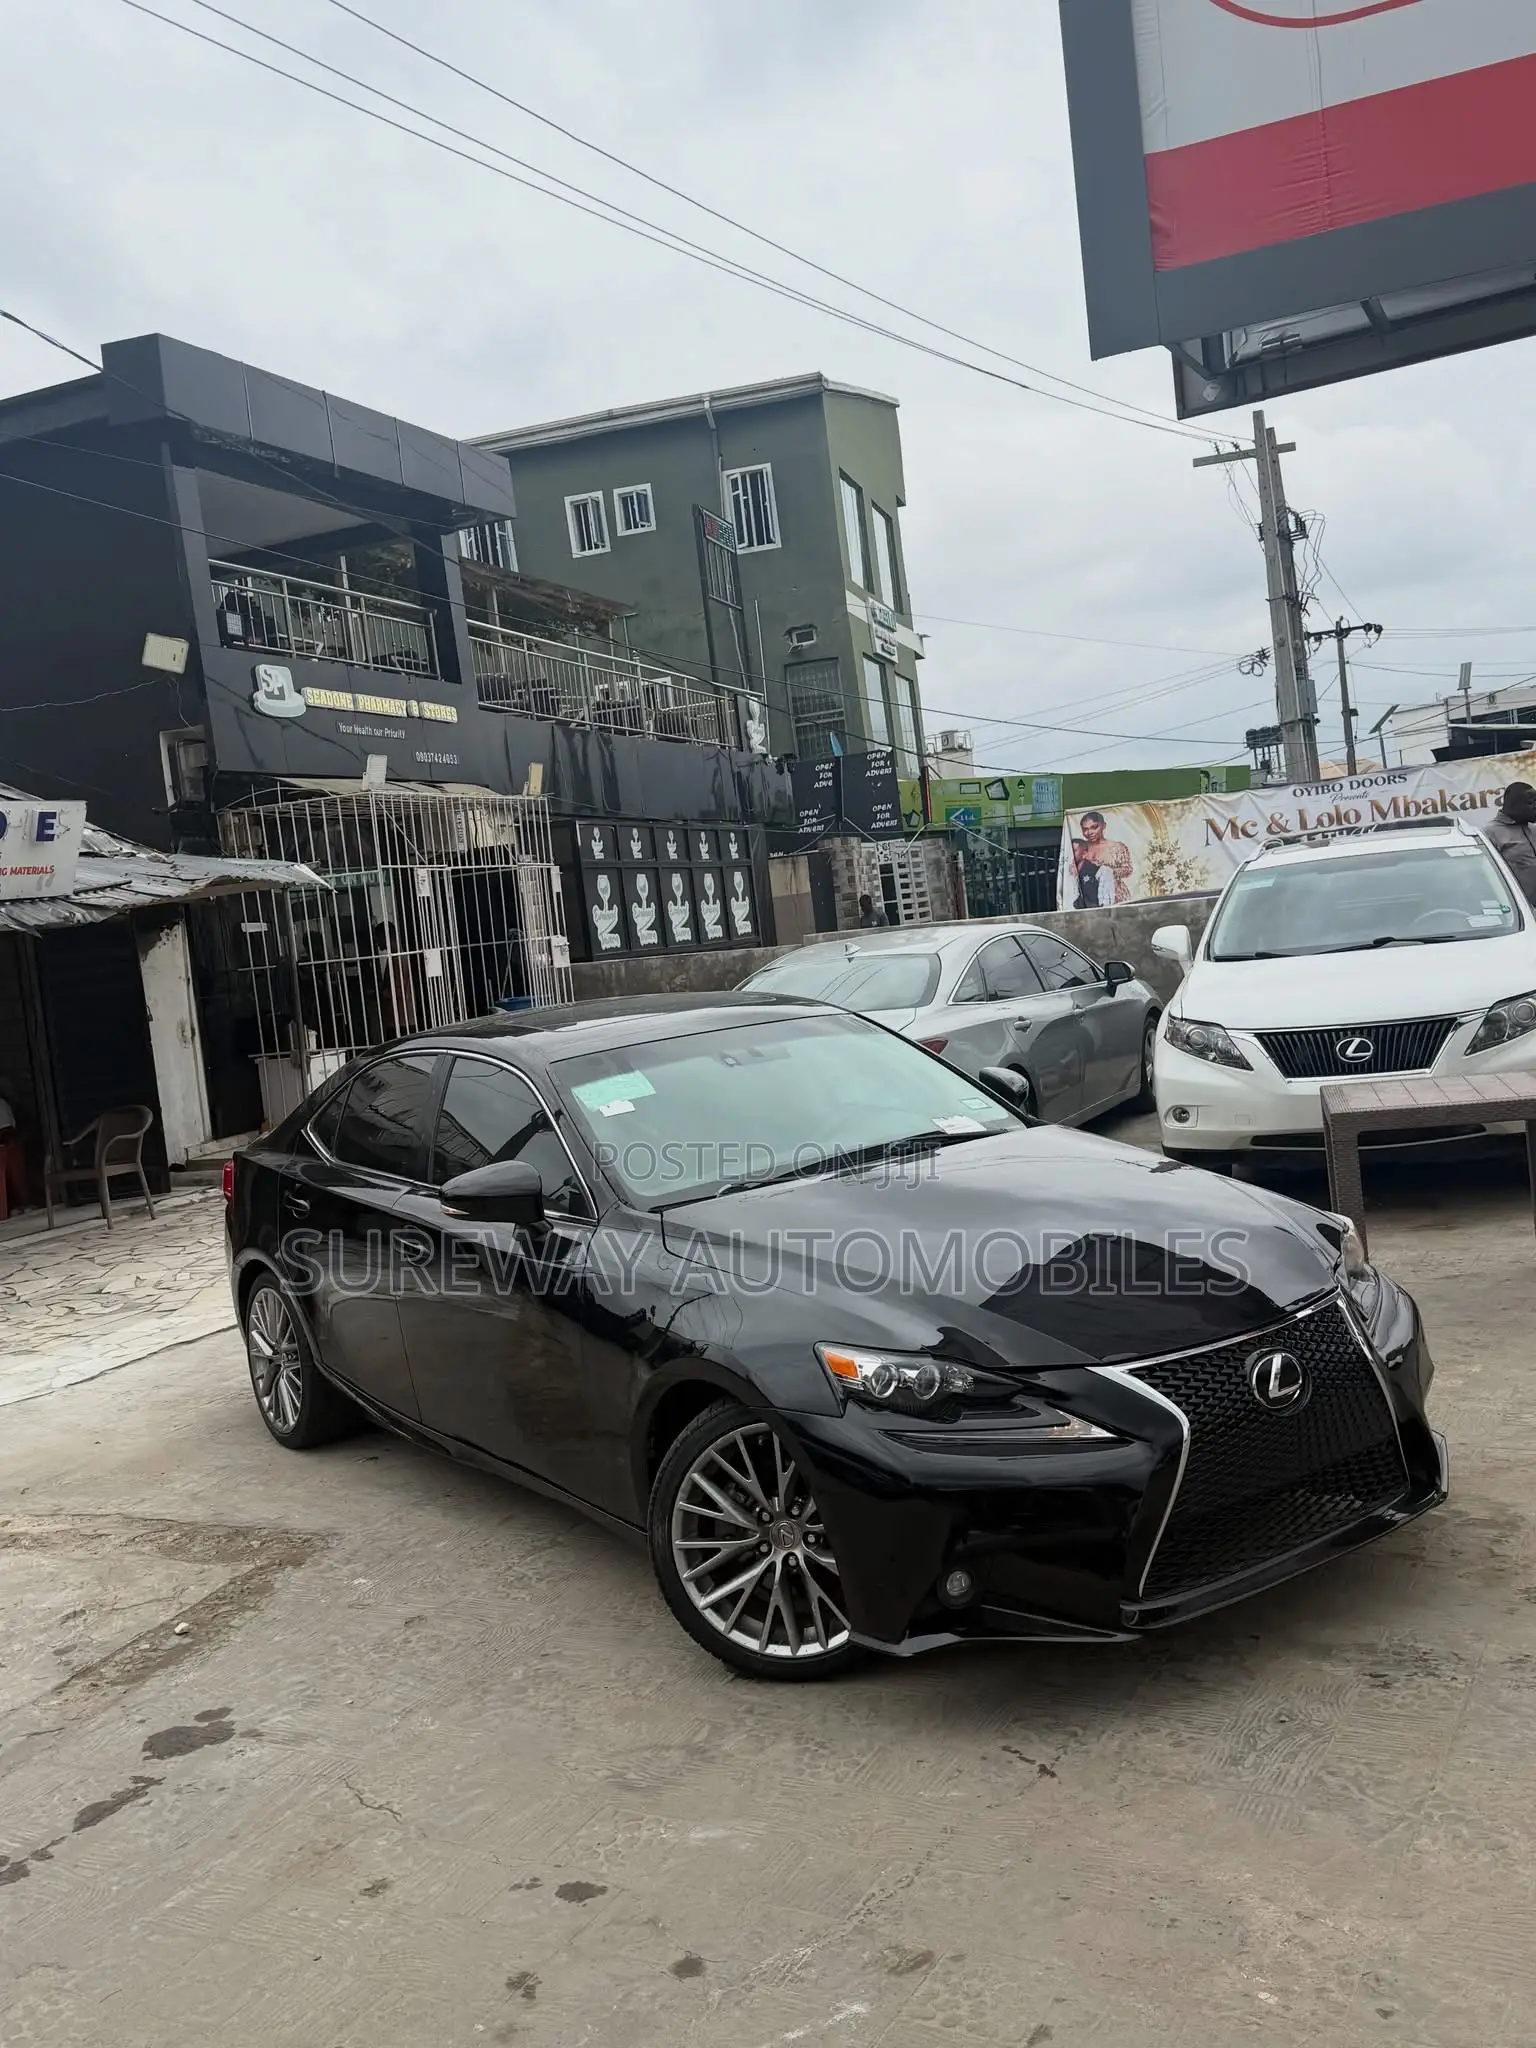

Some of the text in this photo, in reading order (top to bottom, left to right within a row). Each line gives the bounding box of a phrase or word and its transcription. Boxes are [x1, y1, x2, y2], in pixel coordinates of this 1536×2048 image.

[357, 695, 407, 715] PHARMACY
[422, 705, 457, 722] STORES
[338, 722, 406, 739] Your Health our Priority
[866, 751, 888, 761] OPEN
[871, 760, 885, 768] FOR
[865, 767, 892, 778] ADVERT
[1292, 773, 1409, 799] OYIBO DOORS
[799, 808, 819, 818] OPEN
[872, 803, 893, 813] OPEN
[876, 812, 891, 821] FOR
[870, 819, 898, 830] ADVERT
[1202, 815, 1260, 847] Mc
[1266, 811, 1293, 836] &
[1296, 804, 1362, 832] Lolo
[9, 865, 55, 876] MATERIALS
